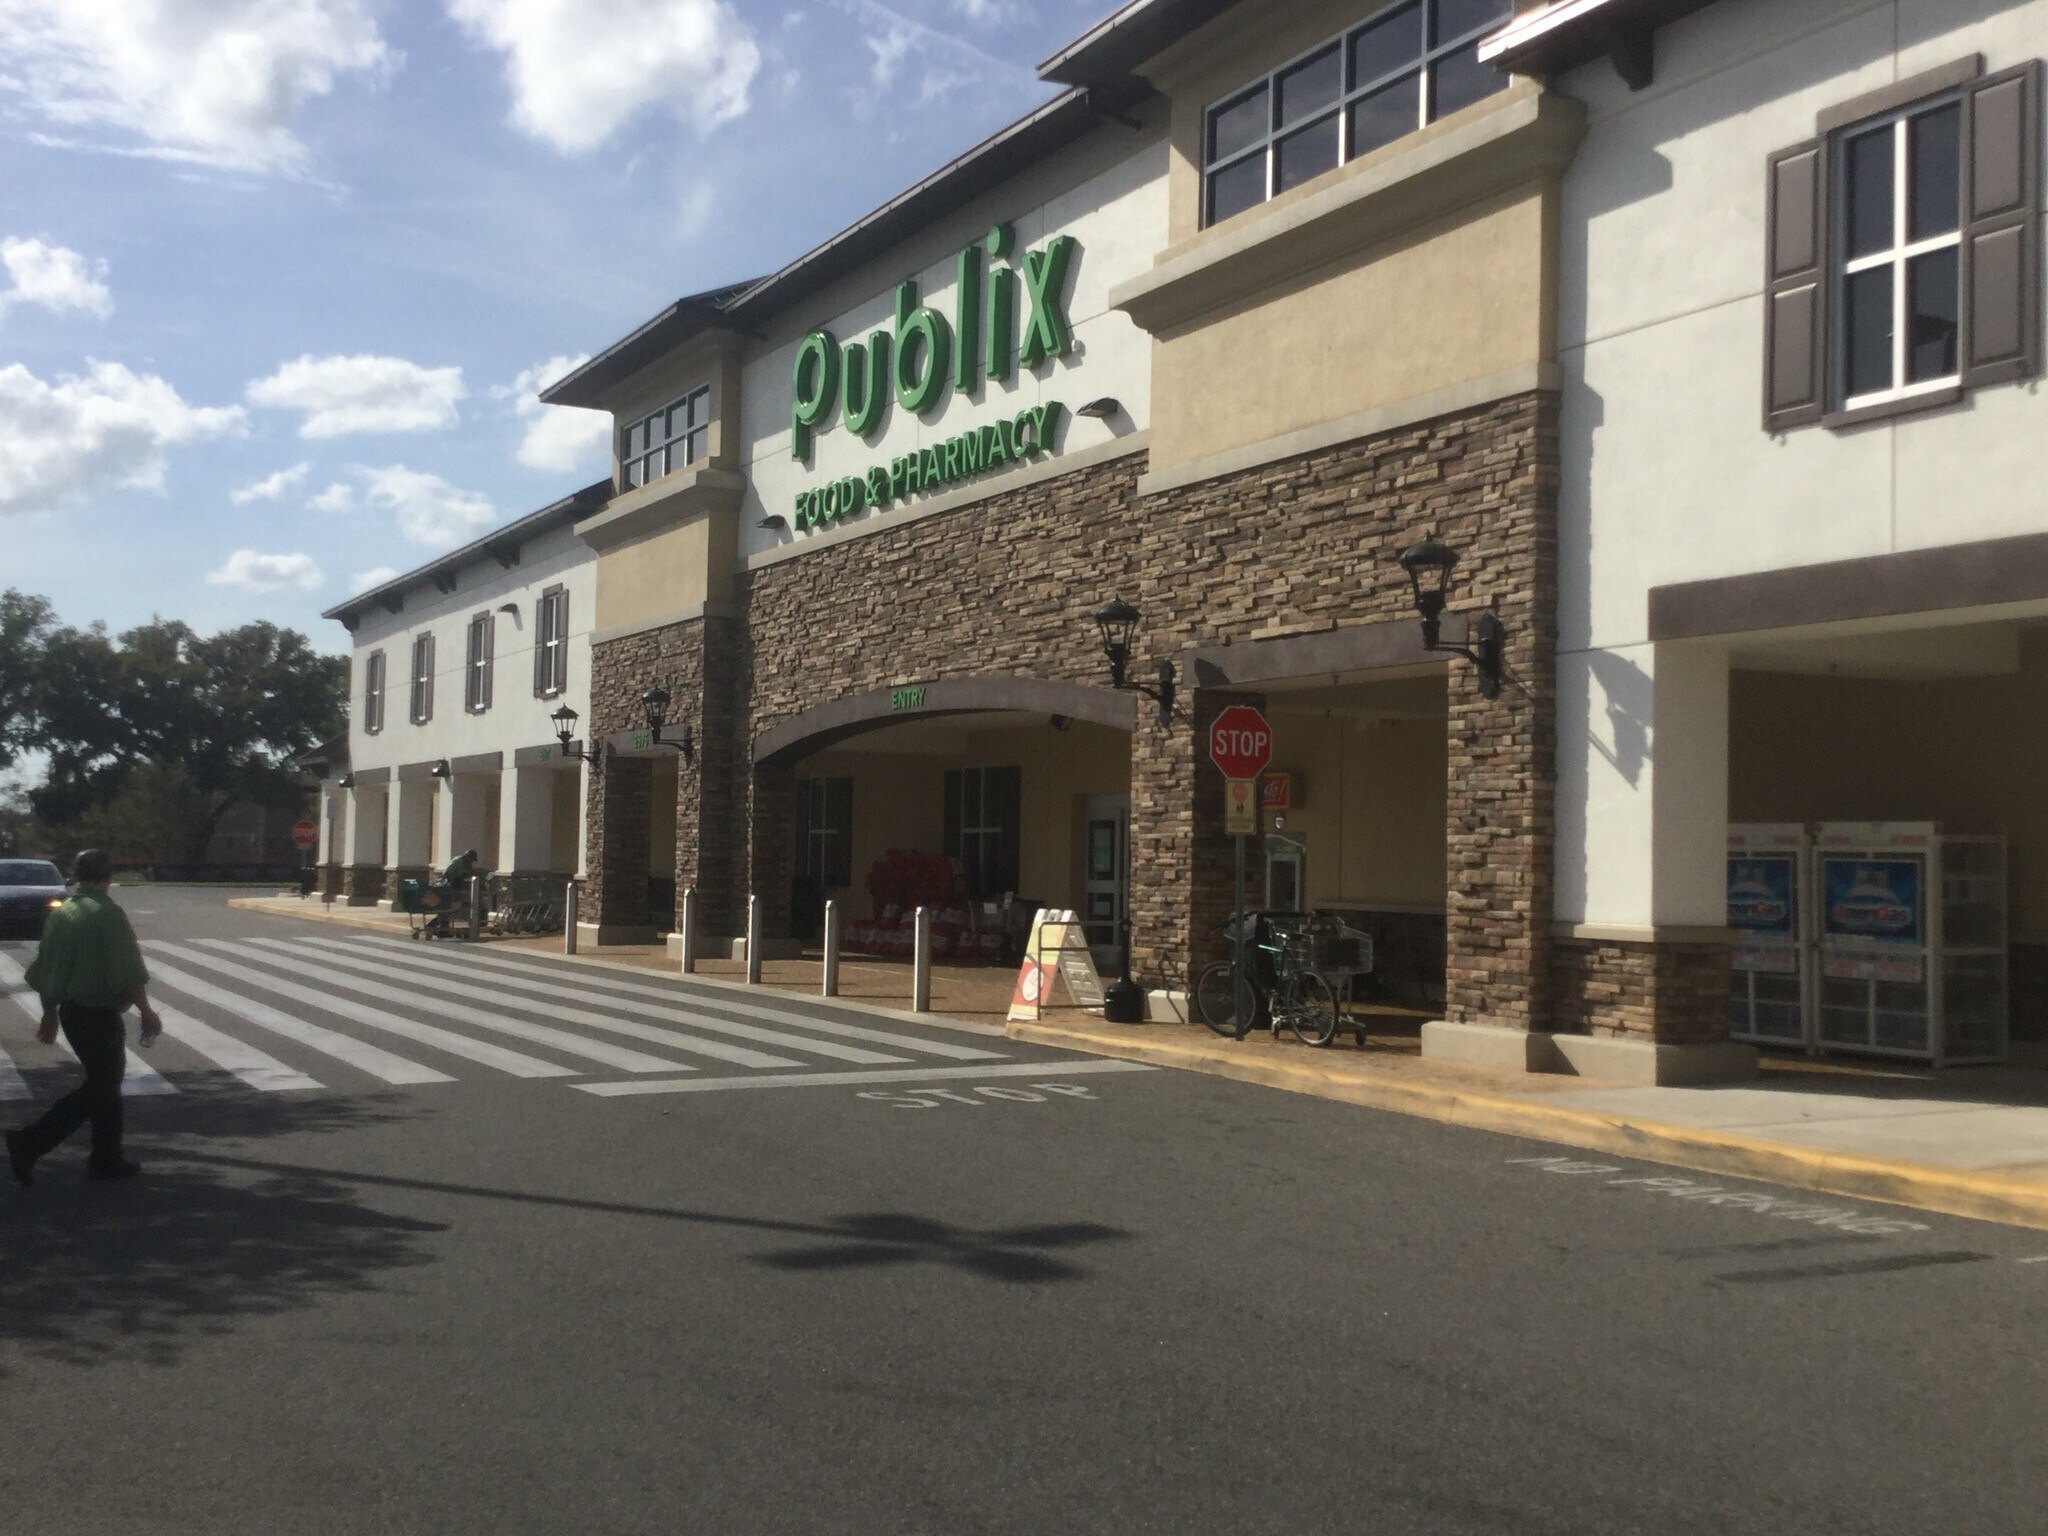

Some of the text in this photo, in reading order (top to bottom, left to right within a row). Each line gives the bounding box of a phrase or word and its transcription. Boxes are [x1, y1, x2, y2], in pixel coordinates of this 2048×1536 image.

[792, 223, 1076, 462] Publix
[795, 400, 1063, 531] FOOD & PHARMACY
[892, 687, 926, 710] ENTRY
[1215, 729, 1267, 757] STOP
[856, 1083, 1099, 1108] STOP
[1505, 1157, 1931, 1234] NO PARKING
